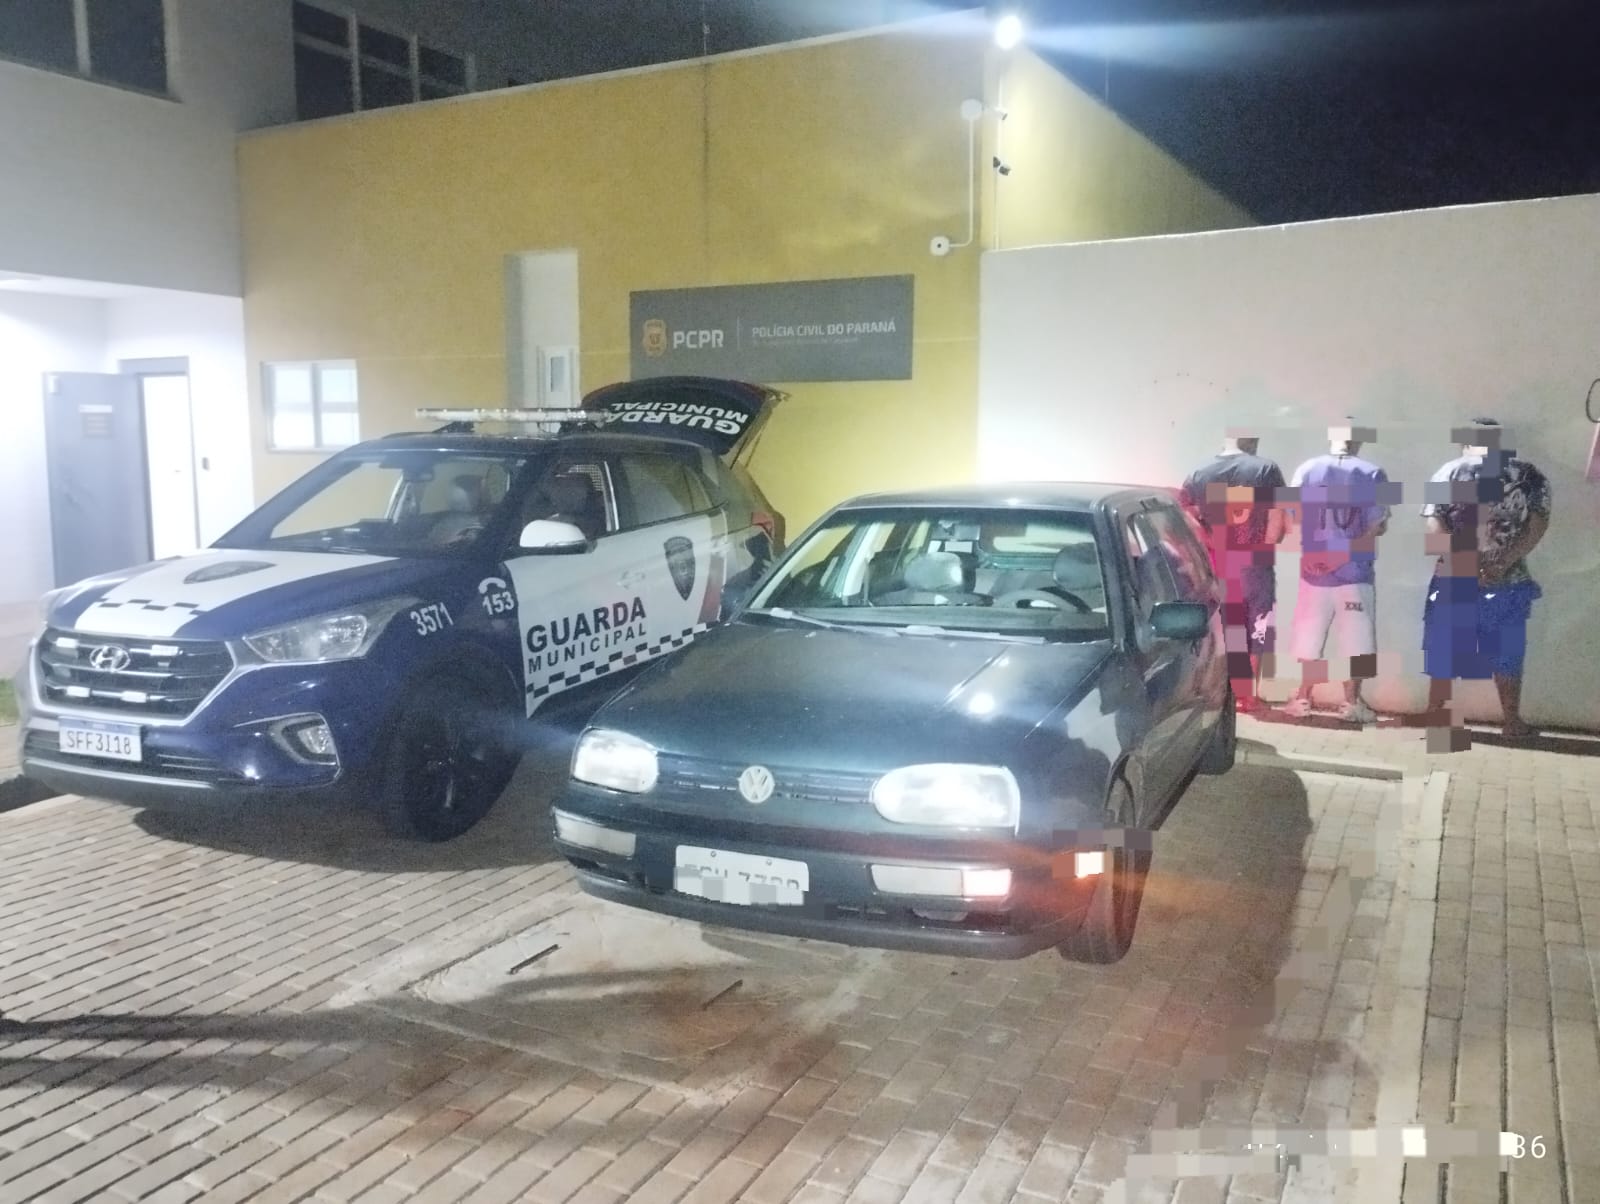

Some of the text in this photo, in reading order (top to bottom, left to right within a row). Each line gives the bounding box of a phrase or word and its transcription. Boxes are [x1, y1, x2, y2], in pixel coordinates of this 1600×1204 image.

[672, 329, 725, 349] PCPR
[751, 318, 897, 339] POLÍCIA CIVIL DO PARANÁ
[610, 401, 749, 424] MUNICIPAL
[482, 591, 515, 616] 153
[410, 602, 454, 637] 3571
[526, 596, 647, 653] GUARDA
[528, 622, 647, 674] MUNICIPAL
